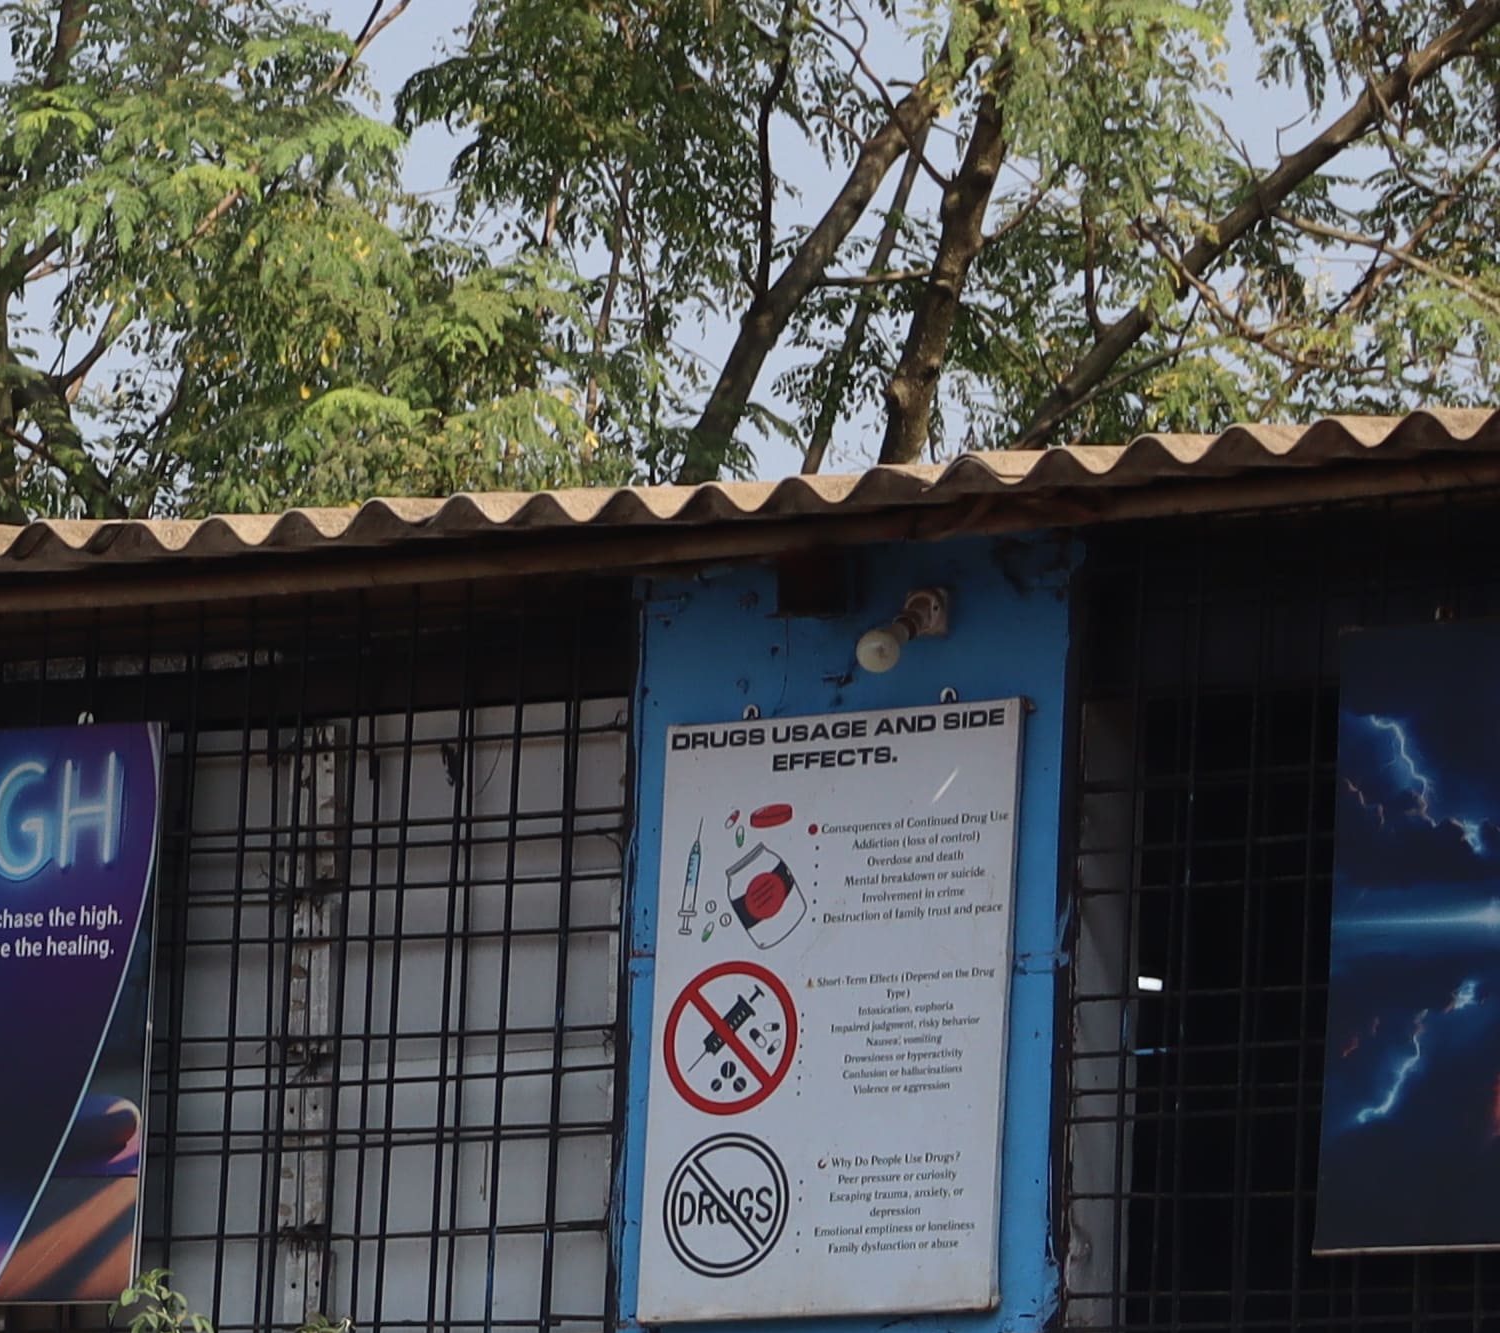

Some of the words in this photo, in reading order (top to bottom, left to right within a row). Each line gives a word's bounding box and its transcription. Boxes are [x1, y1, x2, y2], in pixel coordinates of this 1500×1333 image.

[671, 728, 765, 750] DRUGS
[772, 720, 868, 743] USAGE
[874, 714, 936, 736] AND
[943, 708, 1005, 729] SIDE
[772, 746, 898, 771] EFFECTS.
[822, 821, 892, 834] Consequences
[895, 819, 904, 828] of
[907, 814, 959, 828] Continued
[962, 813, 987, 824] Drug
[991, 811, 1008, 821] Use
[852, 839, 899, 850] Addiction
[903, 836, 926, 848] (loss
[929, 834, 938, 844] of
[941, 831, 980, 843] control)
[867, 856, 912, 867] Overdose
[915, 852, 934, 863] and
[937, 850, 964, 862] death
[845, 875, 878, 887] Mental
[881, 870, 935, 883] breakdown
[938, 870, 948, 879] or
[951, 867, 985, 877] suicide
[862, 892, 922, 903] Involvement
[925, 890, 935, 898] in
[937, 887, 965, 897] crime
[48, 908, 76, 927] the
[79, 904, 124, 930] high.
[823, 911, 880, 924] Destruction
[883, 910, 893, 920] of
[895, 907, 924, 919] family
[928, 905, 951, 916] trust
[953, 903, 972, 913] and
[975, 903, 1003, 915] peace
[14, 937, 42, 957] the
[45, 935, 114, 959] healing.
[817, 976, 867, 987] Short-Term
[870, 974, 899, 984] Effects
[901, 971, 940, 984] (Depend
[942, 970, 952, 978] on
[955, 968, 969, 978] the
[971, 967, 995, 978] Drug
[887, 989, 910, 1000] Type)
[831, 1023, 870, 1034] Impaired
[871, 1021, 916, 1032] judgment,
[919, 1019, 940, 1030] risky
[942, 1017, 980, 1026] behavior
[831, 1157, 851, 1169] Why
[855, 1156, 868, 1167] Do
[871, 1154, 902, 1167] People
[905, 1153, 922, 1164] Use
[925, 1151, 960, 1164] Drugs?
[838, 1174, 858, 1185] Peer
[861, 1173, 901, 1185] pressure
[903, 1172, 914, 1181] or
[916, 1169, 956, 1181] curiosity
[829, 1192, 872, 1204] Escaping
[874, 1190, 912, 1200] trauma,
[914, 1187, 950, 1199] anxiety,
[953, 1187, 964, 1196] or
[870, 1206, 921, 1218] depression
[814, 1225, 863, 1237] Emotional
[865, 1223, 913, 1236] emptiness
[915, 1223, 925, 1232] or
[928, 1220, 975, 1231] loneliness
[828, 1242, 859, 1255] Family
[861, 1240, 916, 1253] dysfunction
[918, 1240, 929, 1249] or
[931, 1238, 958, 1249] abuse
